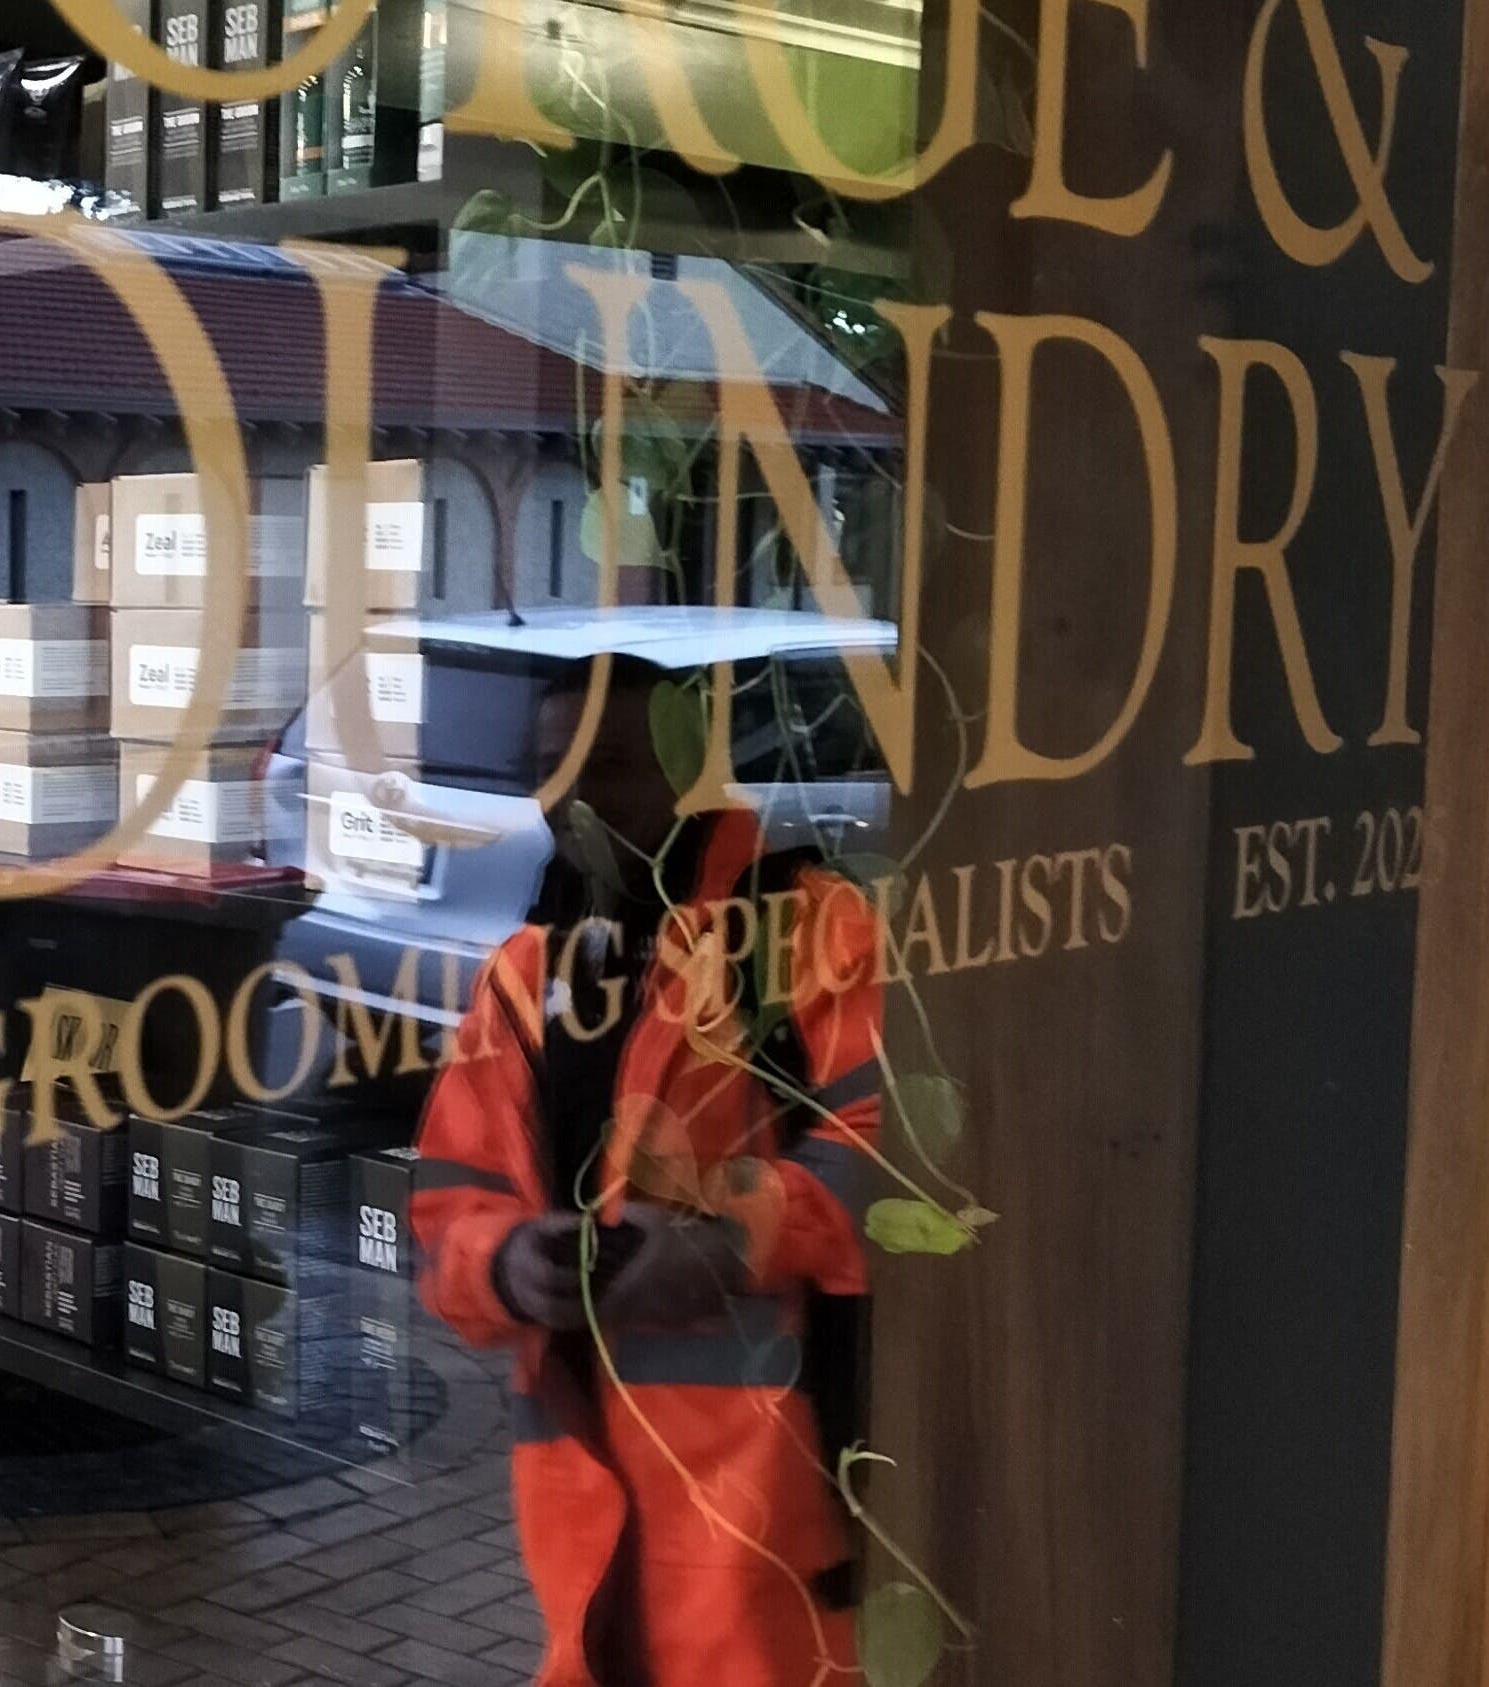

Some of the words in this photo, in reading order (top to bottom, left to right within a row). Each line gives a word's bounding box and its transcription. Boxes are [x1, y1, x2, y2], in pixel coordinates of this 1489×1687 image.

[166, 13, 198, 46] SEB
[224, 4, 258, 38] SEB
[145, 530, 177, 551] Zeal
[138, 663, 170, 683] Zeal
[340, 811, 374, 834] Grit
[1232, 816, 1336, 921] EST.
[1351, 805, 1449, 897] 202
[654, 843, 1134, 1023] SPECIALISTS
[132, 1152, 160, 1179] SEB
[211, 1175, 241, 1204] SEB
[359, 1205, 397, 1243] SEB
[359, 1235, 398, 1273] MAN
[128, 1280, 155, 1309] SEB
[211, 1306, 241, 1336] SEB
